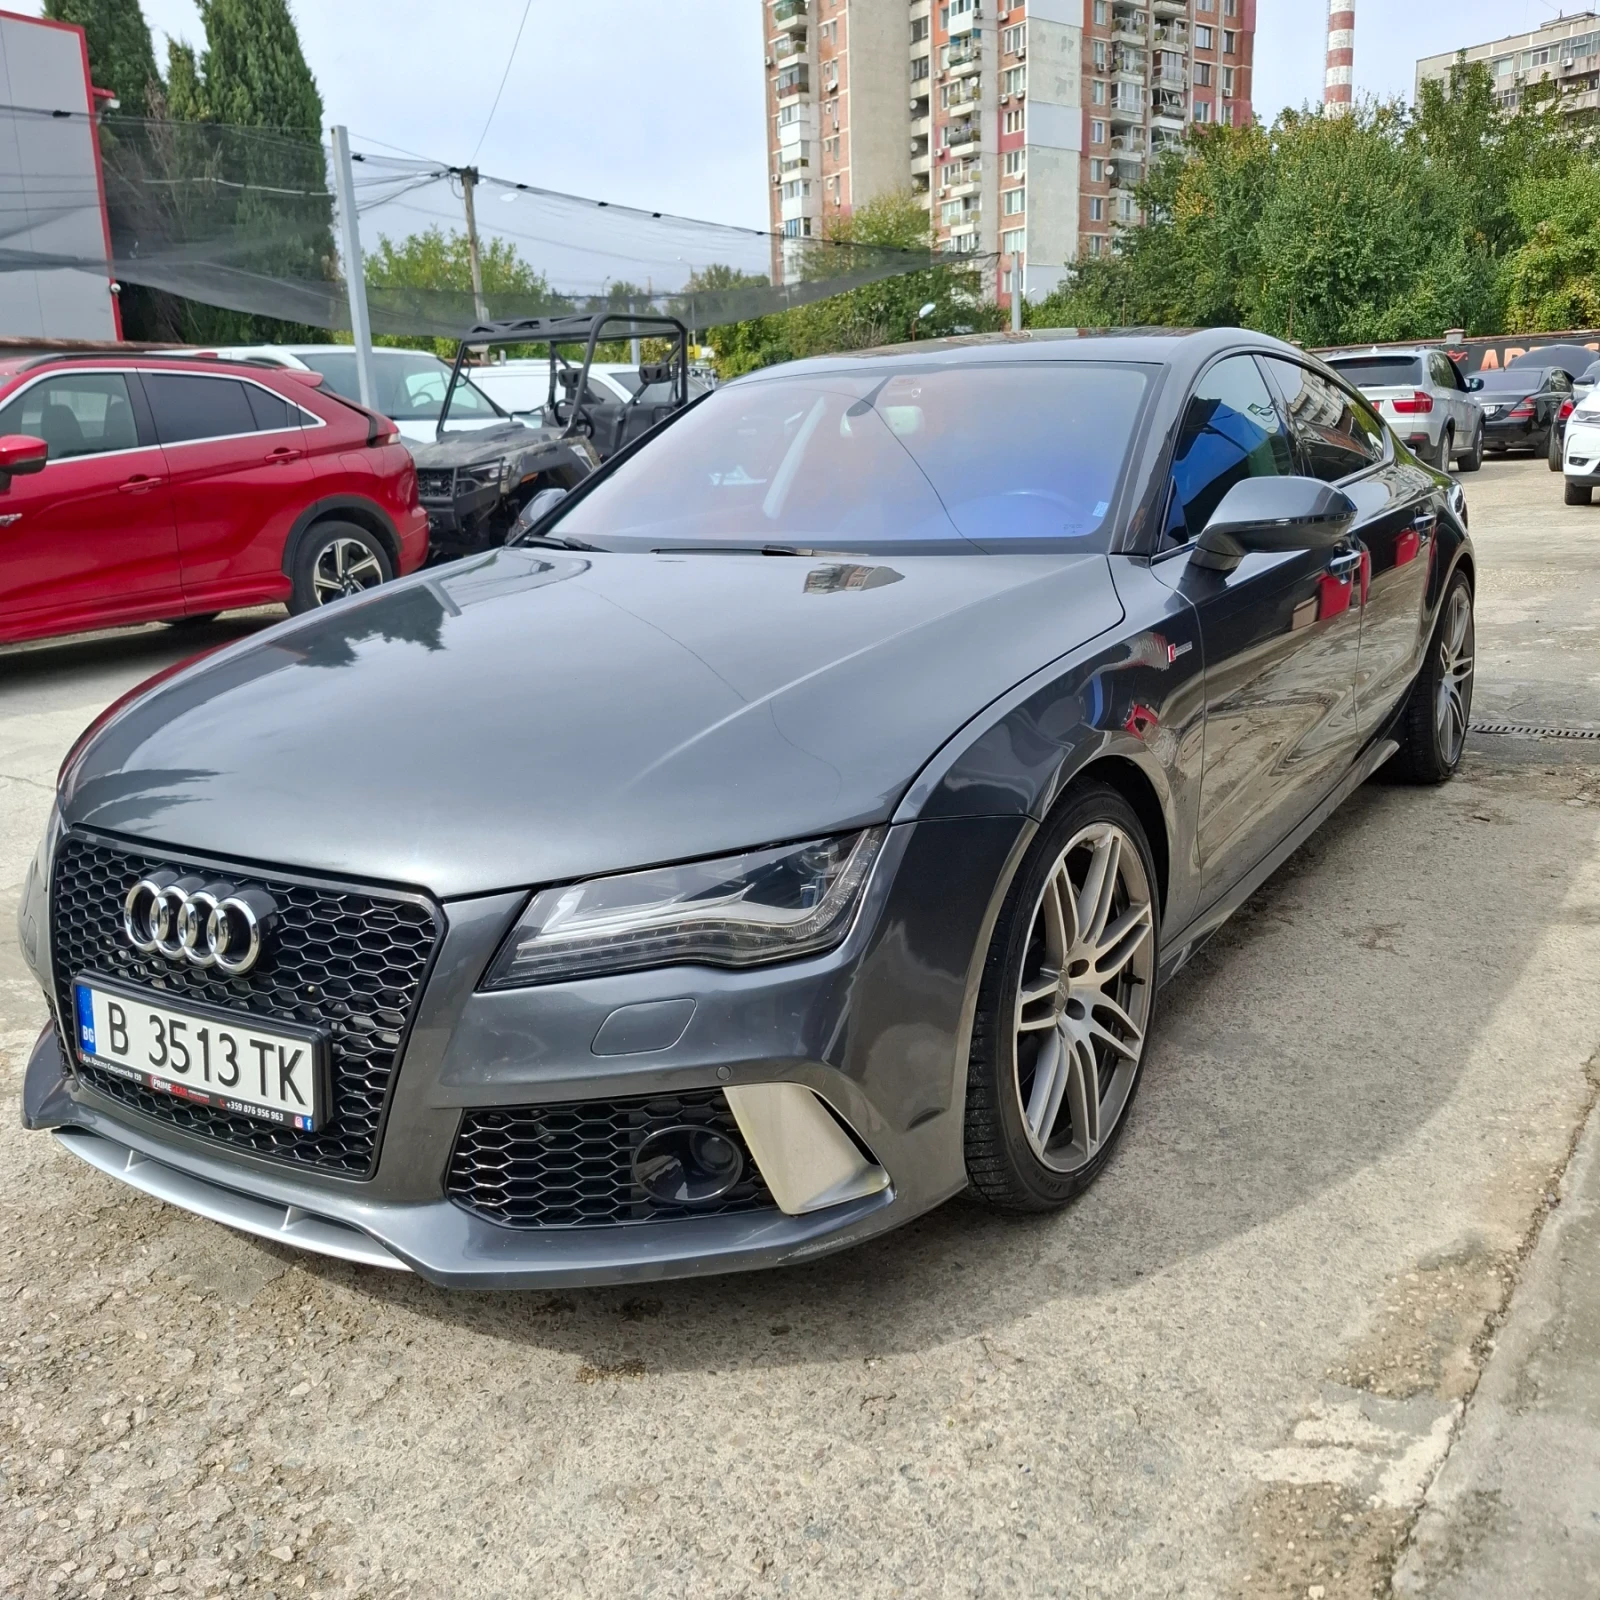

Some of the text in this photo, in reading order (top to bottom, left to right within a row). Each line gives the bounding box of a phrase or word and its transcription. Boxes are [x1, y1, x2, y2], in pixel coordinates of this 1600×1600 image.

[82, 1025, 95, 1043] BG
[107, 1001, 308, 1106] B 3513 TK
[226, 1101, 284, 1122] +359 876 956 963
